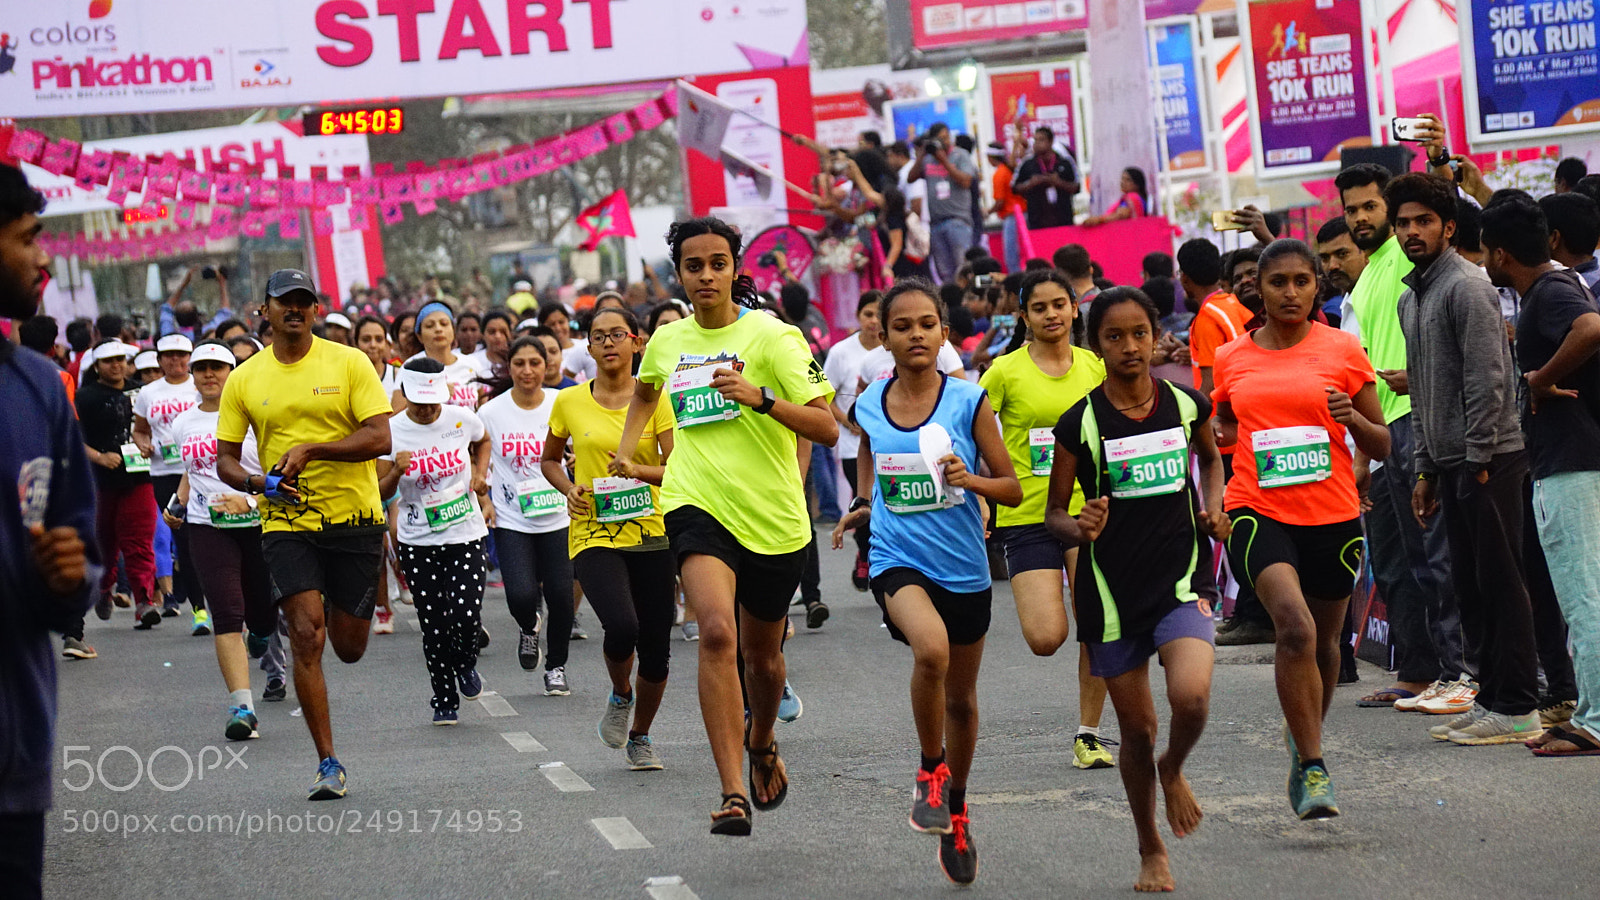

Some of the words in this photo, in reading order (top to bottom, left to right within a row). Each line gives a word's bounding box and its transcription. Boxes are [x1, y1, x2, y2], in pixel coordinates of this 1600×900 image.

[1488, 5, 1526, 30] SHE
[1530, 0, 1595, 25] TEAMS
[30, 22, 116, 46] colors
[314, 0, 627, 68] START
[1491, 28, 1539, 58] 10K
[1545, 22, 1596, 53] RUN
[32, 53, 213, 90] Pinkathon
[1266, 58, 1297, 80] SHE
[1299, 52, 1353, 76] TEAMS
[1551, 58, 1570, 69] Mar
[241, 77, 291, 88] BAJAJ
[1269, 78, 1309, 103] 10K
[1312, 72, 1355, 99] RUN
[320, 108, 403, 135] 6:45:03
[508, 432, 525, 440] AM
[528, 432, 535, 440] A
[182, 440, 217, 461] PIN
[502, 441, 546, 457] PIN
[1276, 449, 1329, 472] 50096
[404, 449, 463, 476] PINK
[1133, 455, 1185, 483] 50101
[532, 493, 563, 507] 50099
[613, 491, 651, 511] 50038
[900, 481, 935, 499] 500
[440, 498, 470, 520] 50050
